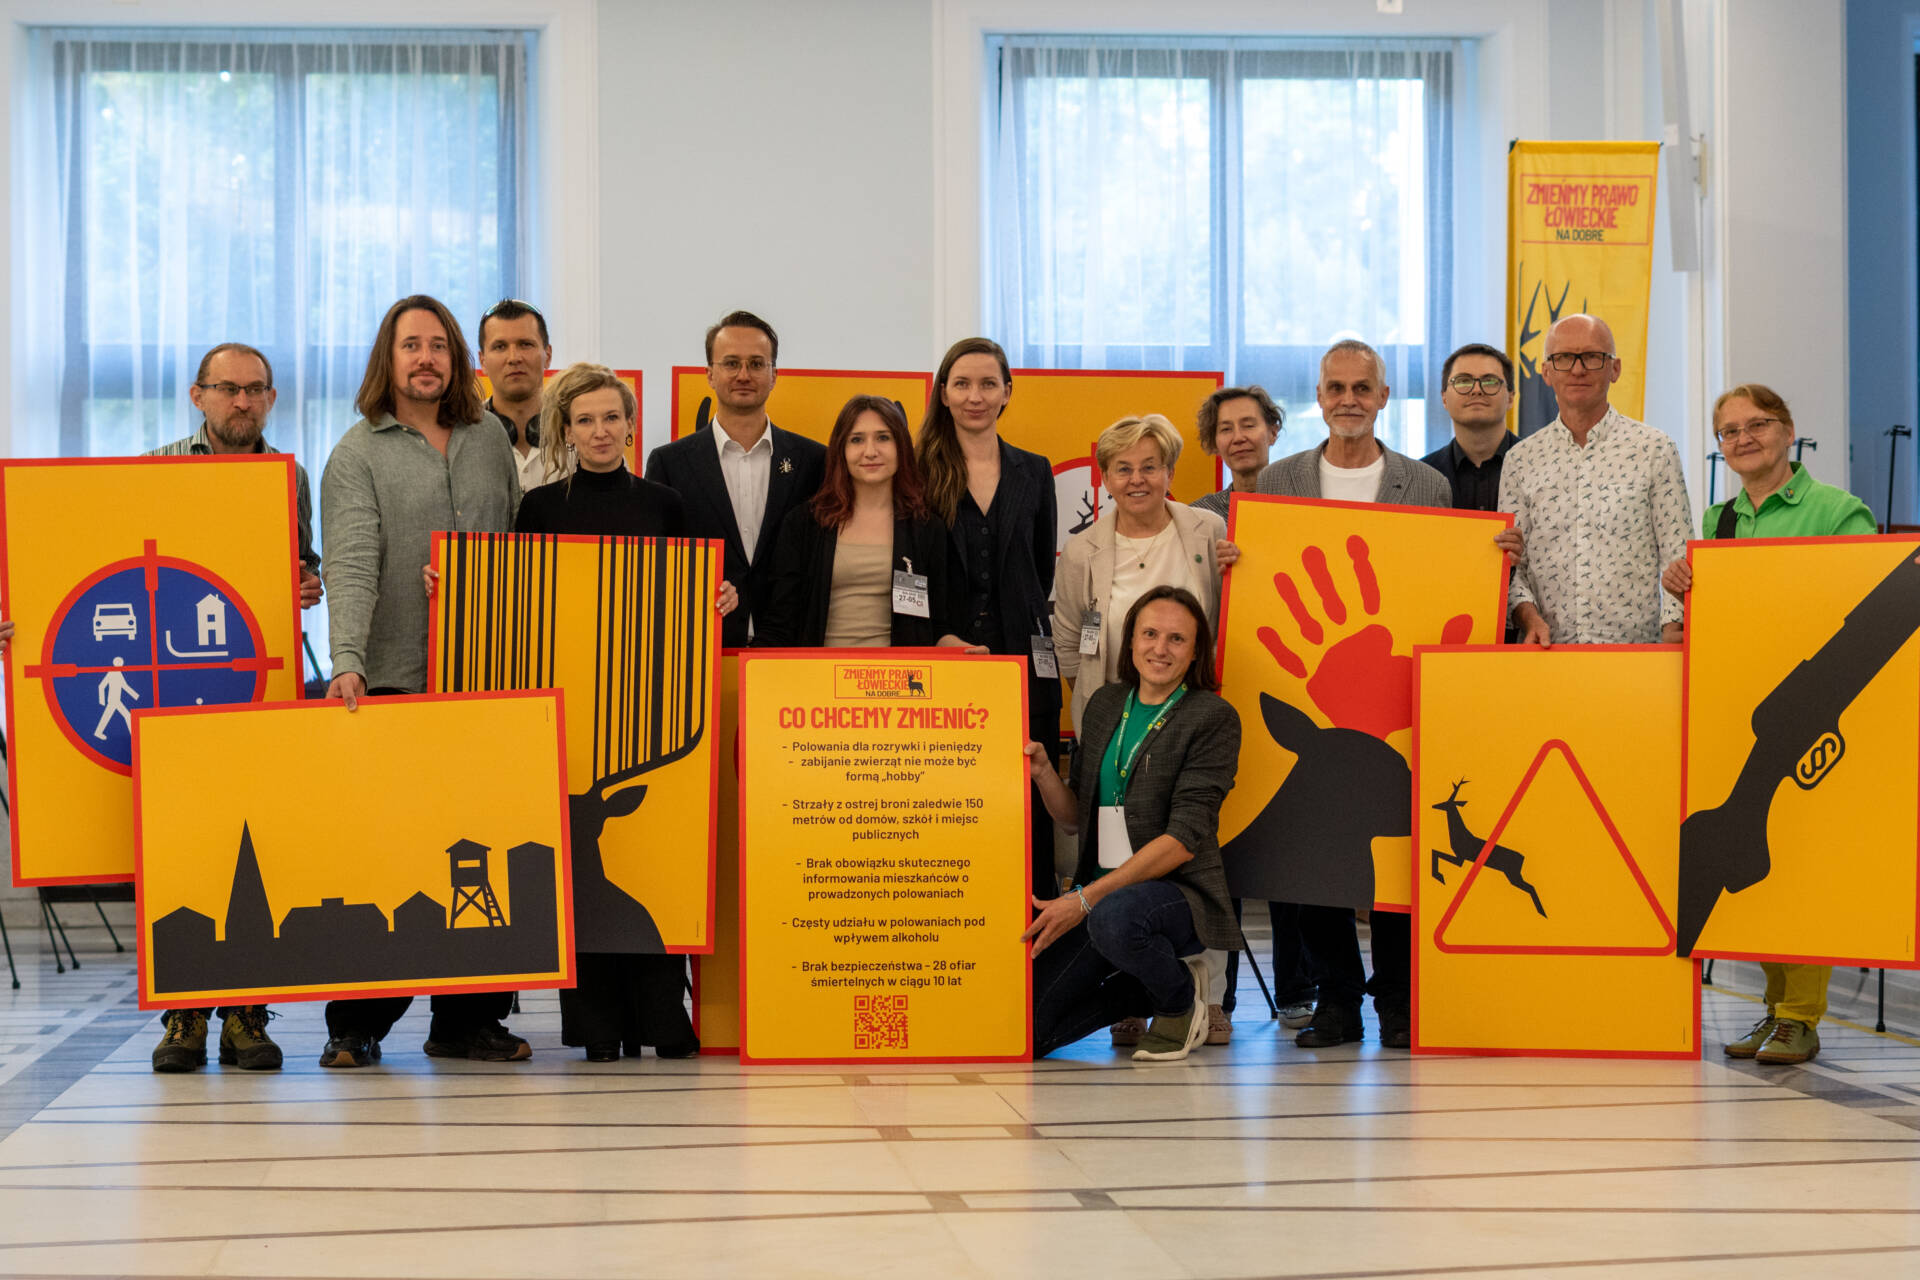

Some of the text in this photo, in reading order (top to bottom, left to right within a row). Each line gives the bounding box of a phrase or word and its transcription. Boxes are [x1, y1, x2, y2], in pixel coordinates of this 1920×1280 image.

[1527, 178, 1639, 206] ZMIEŃMY PRAWO
[1544, 206, 1619, 229] ŁOWIECKIE
[1556, 229, 1605, 242] NA DOBRE
[843, 665, 923, 681] ZMIEŃMY PRAWO
[856, 679, 909, 691] ŁOWIECKIE
[779, 703, 990, 730] CO CHCEMY ZMIENIĆ?
[792, 741, 850, 752] Polowania
[852, 741, 870, 752] dla
[871, 741, 921, 754] rozrywki
[923, 741, 926, 752] i
[928, 741, 983, 754] pieniędzy
[801, 755, 852, 769] zabijanie
[853, 755, 902, 769] zwierząt
[904, 755, 922, 766] nie
[924, 755, 955, 766] może
[956, 756, 977, 769] być
[845, 771, 880, 784] formą
[792, 799, 835, 812] Strzały
[836, 801, 843, 810] z
[844, 798, 879, 812] ostrej
[880, 798, 910, 809] broni
[912, 798, 963, 809] zaledwie
[965, 798, 984, 809] 150
[792, 813, 979, 827] metrów od domów, szkół i miejsc
[852, 828, 920, 843] publicznych
[806, 857, 833, 869] Brak
[834, 857, 896, 871] obowiązku
[898, 857, 971, 871] skutecznego
[802, 872, 969, 884] informowania mieszkańców o
[808, 887, 964, 902] prowadzonych polowaniach
[792, 917, 831, 930] Częsty
[832, 916, 875, 928] udziału
[877, 919, 888, 928] w
[890, 916, 962, 930] polowaniach
[963, 915, 986, 929] pod
[833, 931, 940, 946] wpływem alkoholu
[802, 961, 828, 972] Brak
[830, 960, 923, 974] bezpieczeństwa
[932, 959, 947, 971] 28
[949, 959, 977, 971] ofiar
[810, 975, 963, 989] śmiertelnych w ciągu 10 lat
